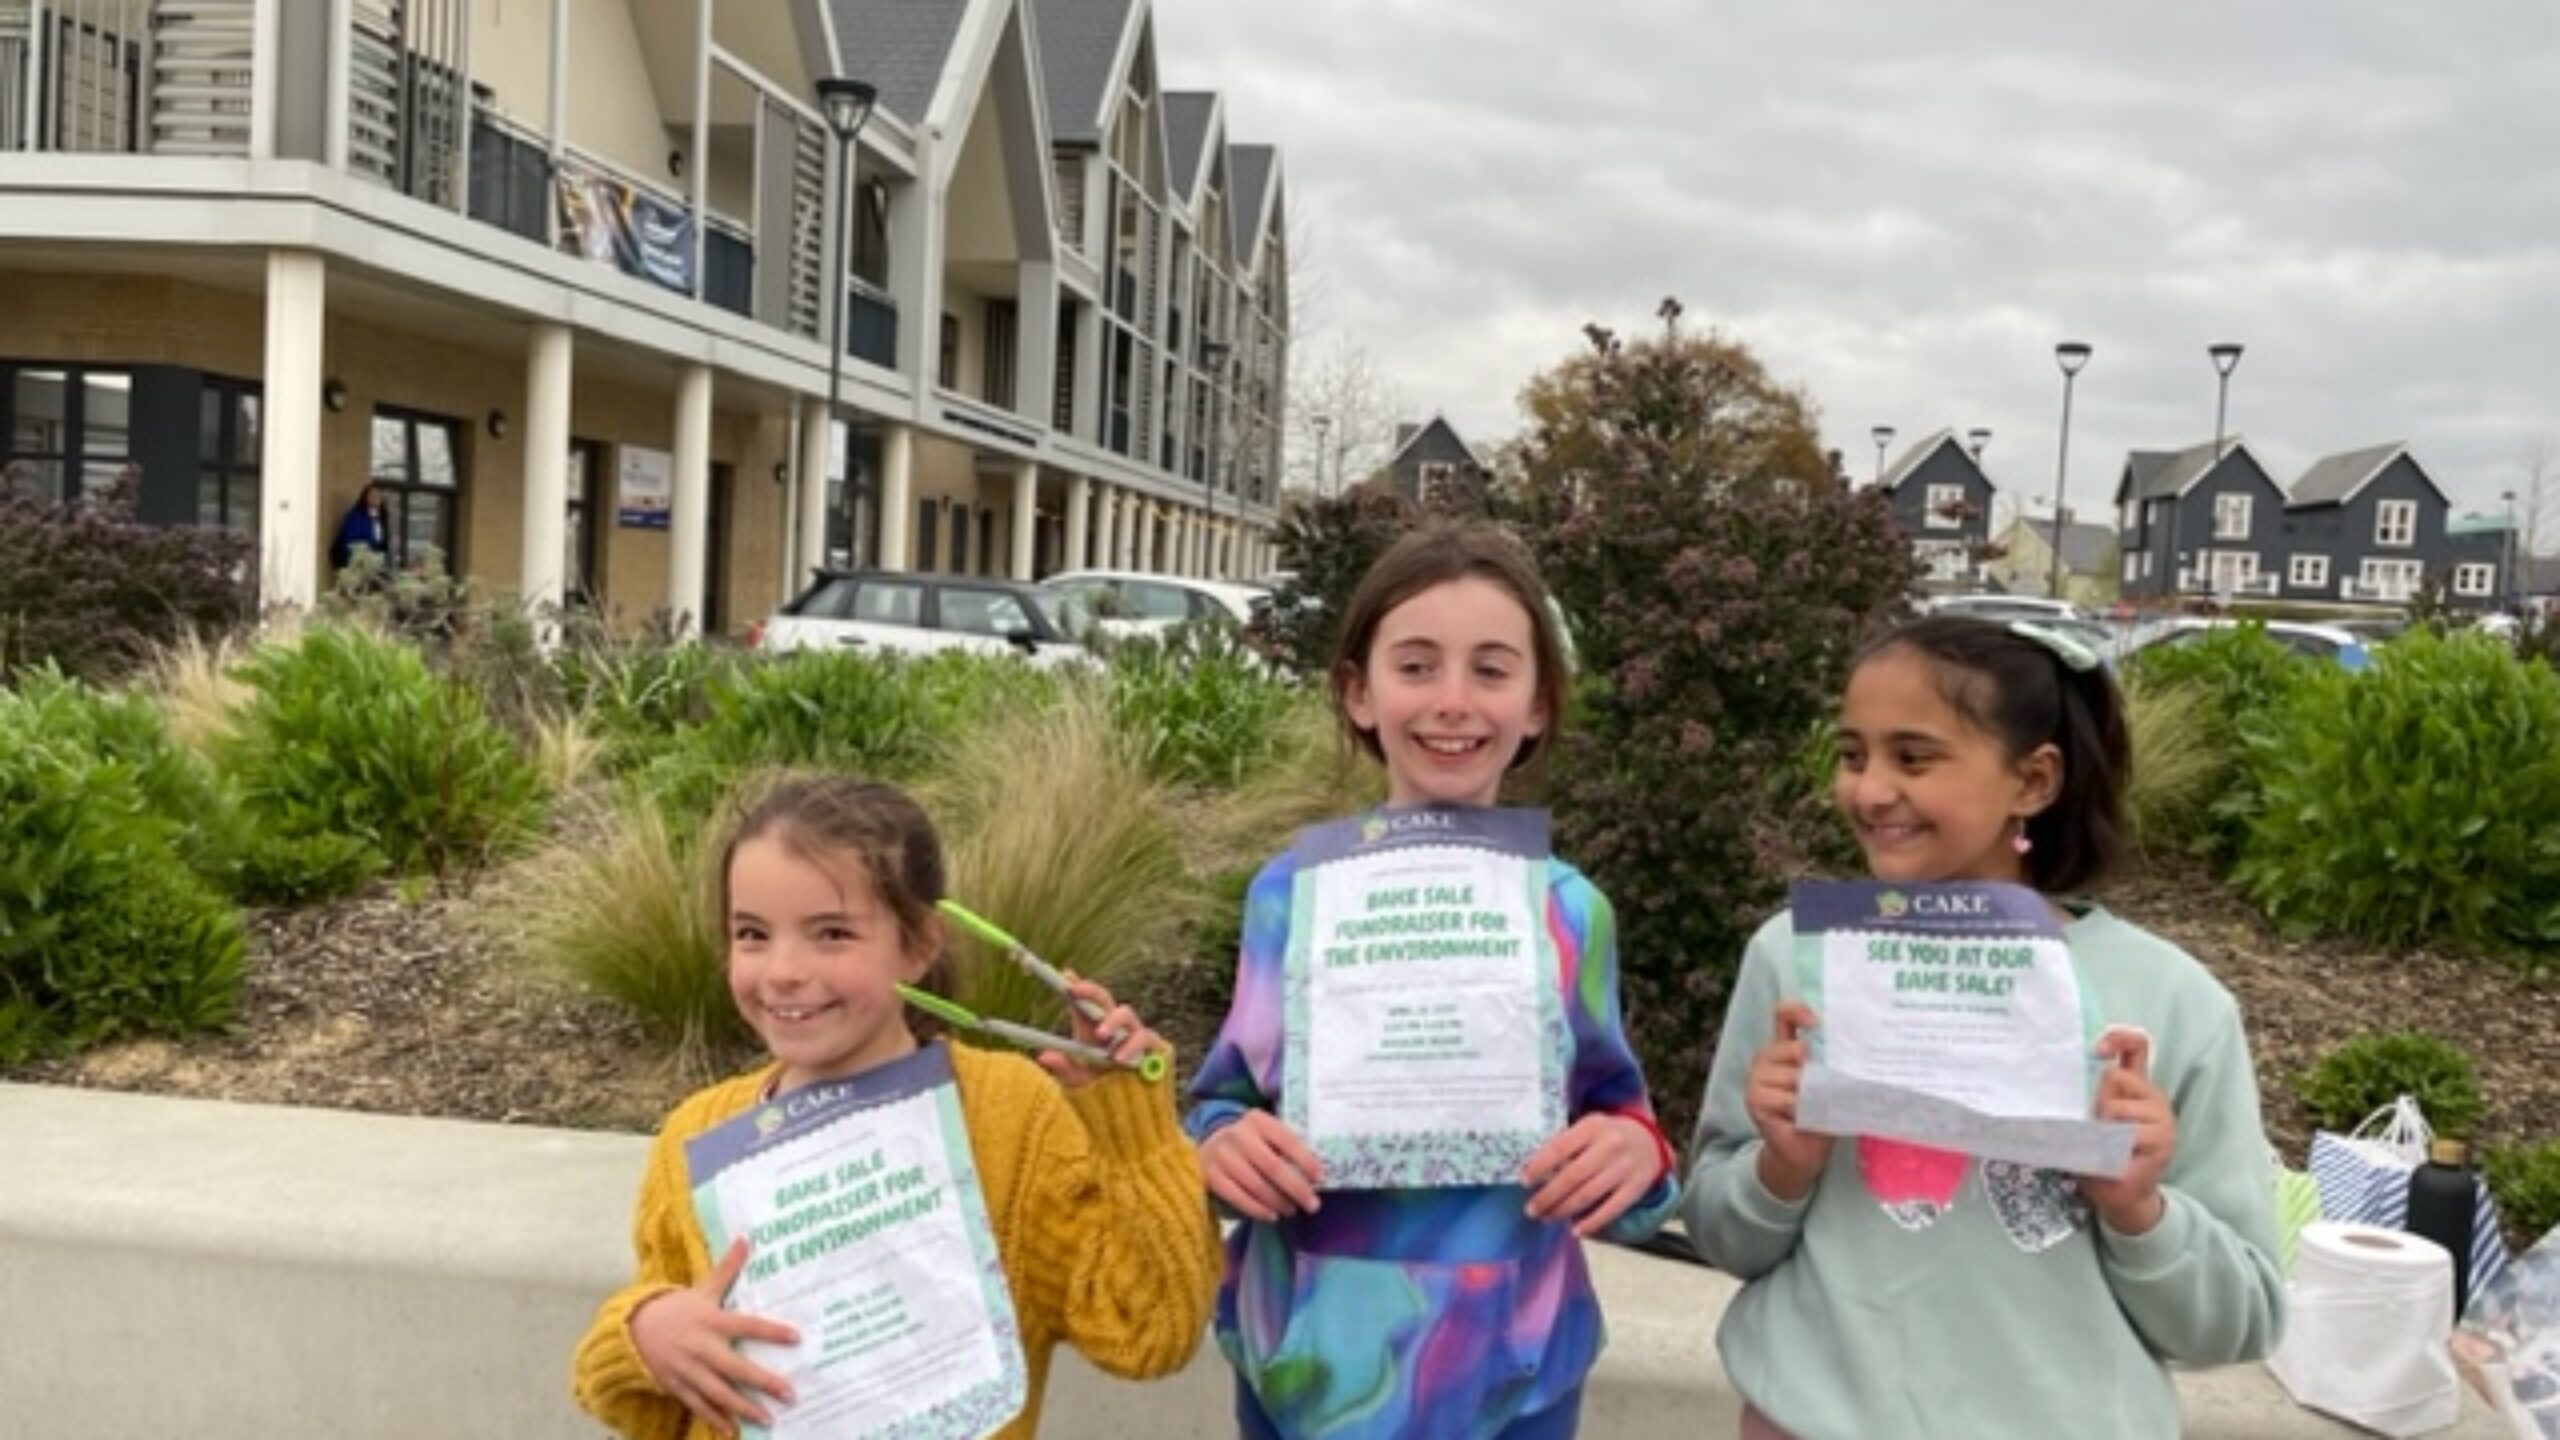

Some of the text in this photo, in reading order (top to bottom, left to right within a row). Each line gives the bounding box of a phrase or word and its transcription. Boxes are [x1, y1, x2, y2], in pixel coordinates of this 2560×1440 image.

[1391, 811, 1456, 830] CAKE
[1367, 884, 1473, 911] BAKE SALE
[1914, 894, 1989, 915] CAKE
[1336, 911, 1508, 940] FUNDRAISER FOR
[1325, 938, 1520, 968] THE ENVIRONMENT
[1867, 938, 2034, 969] SEE YOU AT OUR
[1895, 970, 2014, 997] BAKE SALE!
[786, 1083, 854, 1118] CAKE
[775, 1171, 828, 1210] BAKE
[835, 1147, 885, 1188] SALE
[750, 1164, 926, 1252] FUNDRAISER FOR
[784, 1188, 942, 1267] ENVIRONMENT
